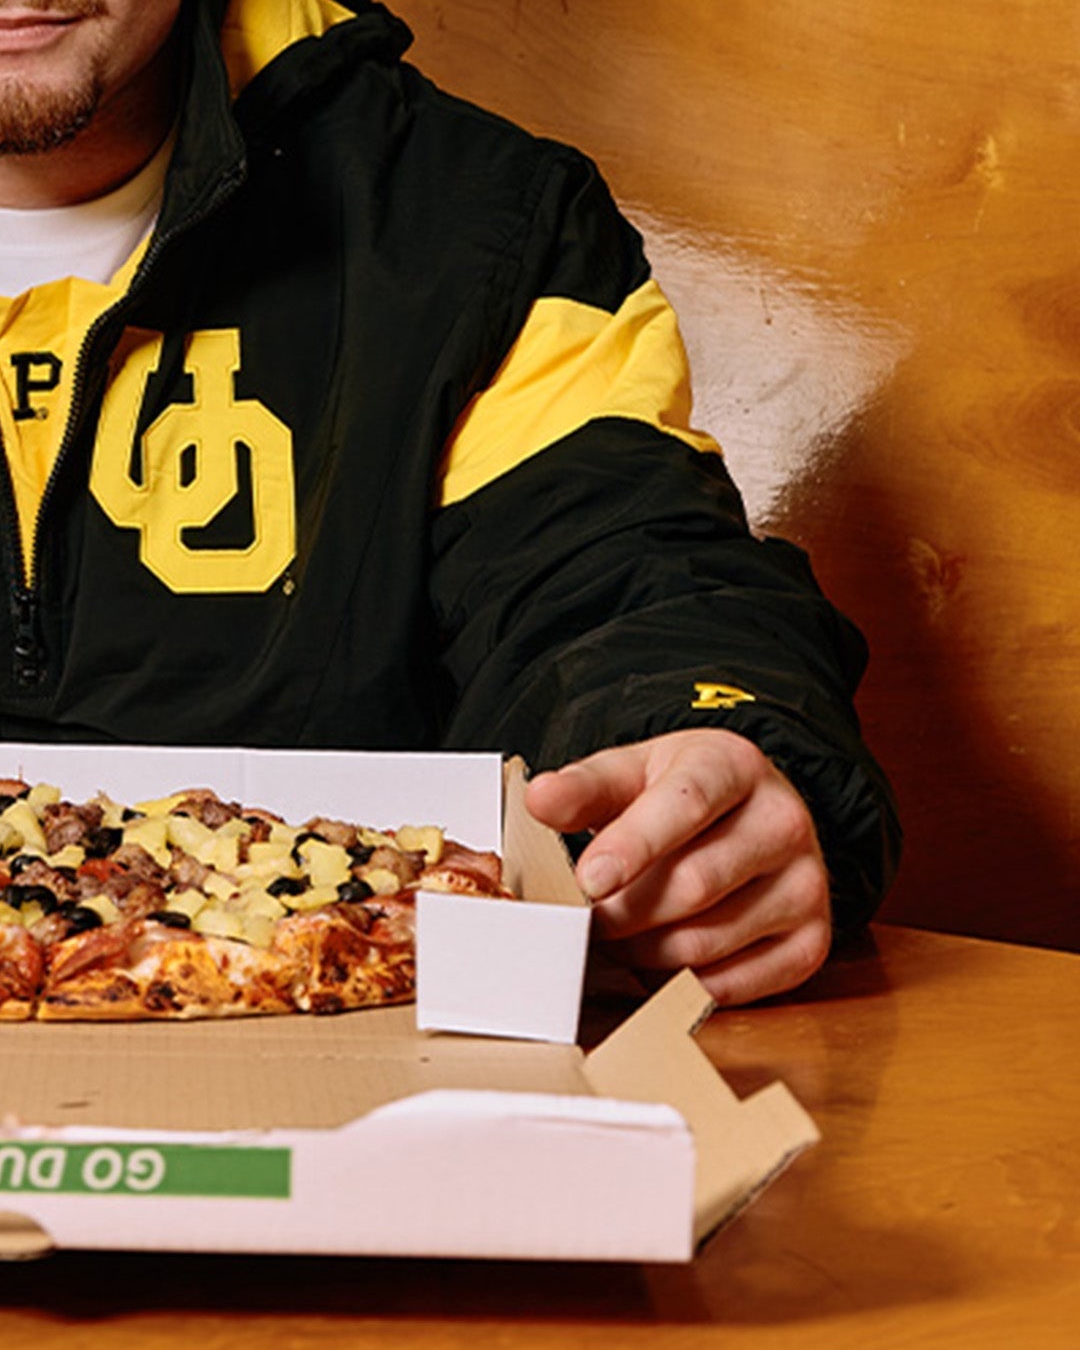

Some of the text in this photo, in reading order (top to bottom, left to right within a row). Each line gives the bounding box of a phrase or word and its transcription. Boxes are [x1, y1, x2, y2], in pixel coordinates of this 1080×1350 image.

[10, 351, 63, 421] P
[88, 326, 297, 595] UO
[82, 1148, 166, 1191] GO
